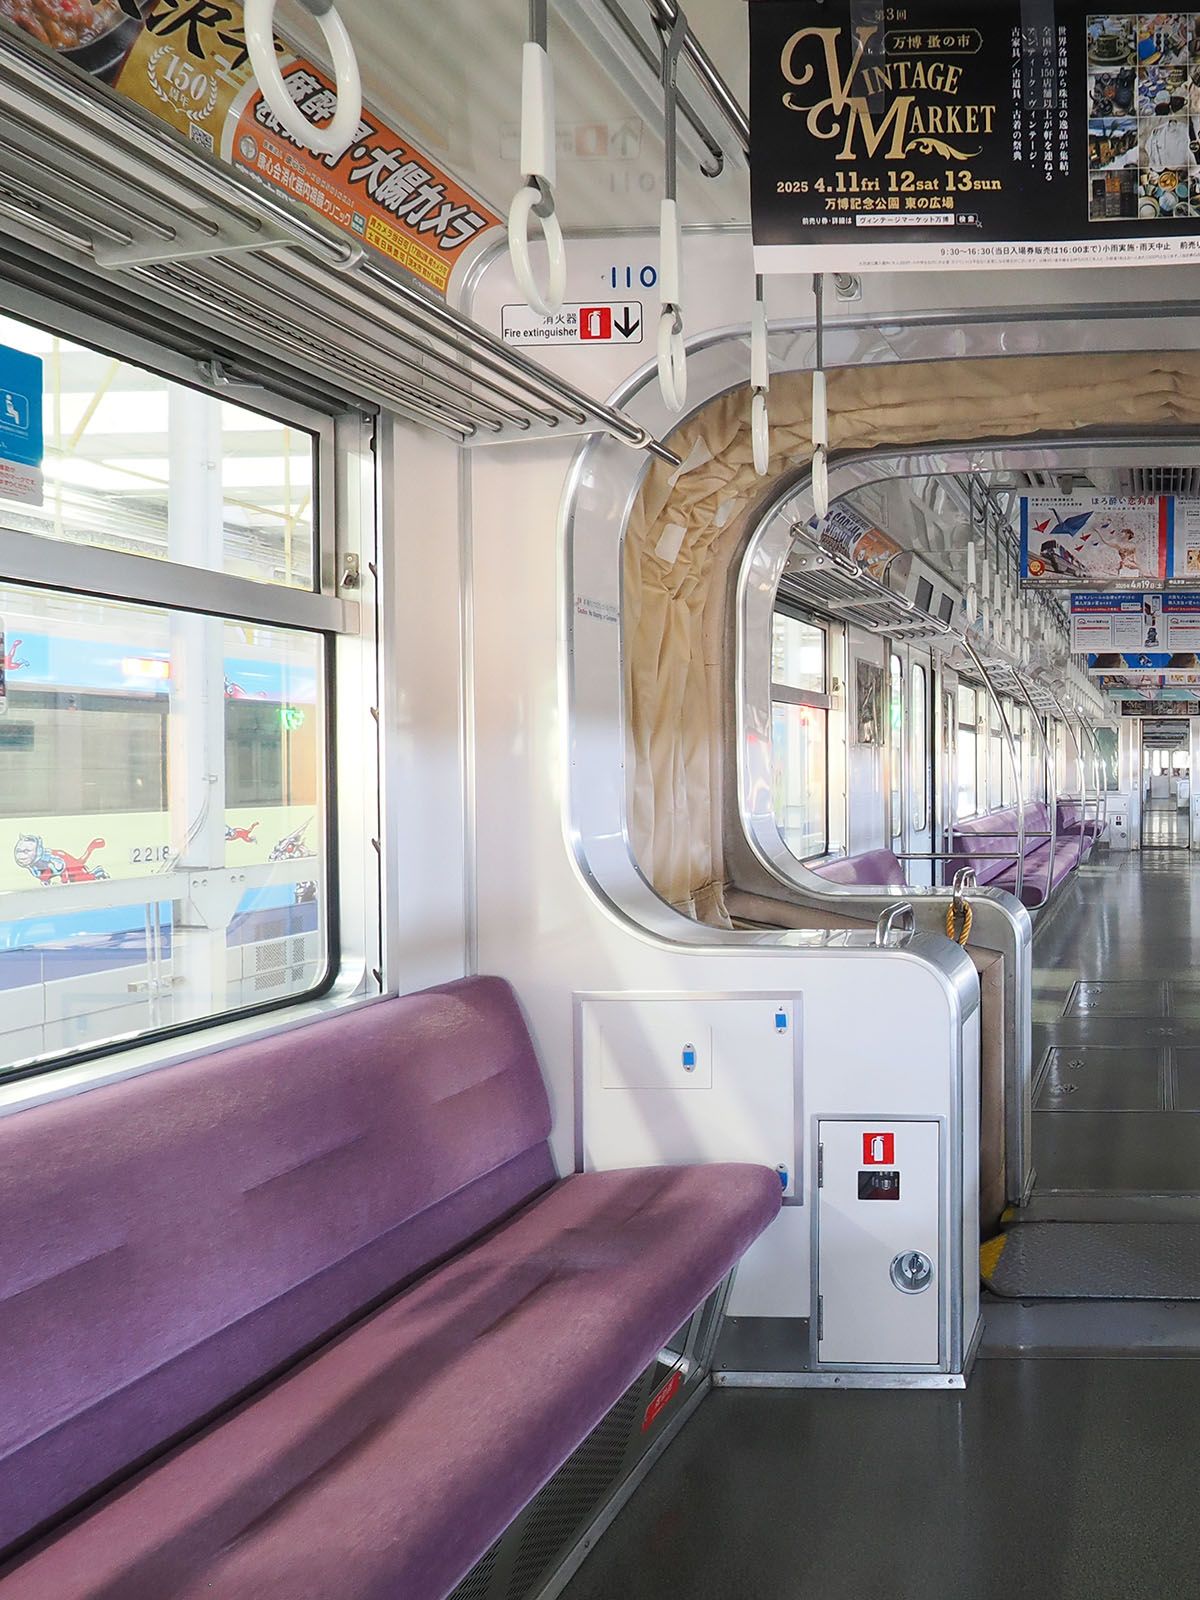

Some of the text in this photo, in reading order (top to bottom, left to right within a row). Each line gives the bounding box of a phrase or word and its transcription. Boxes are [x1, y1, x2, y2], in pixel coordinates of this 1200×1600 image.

[892, 34, 971, 49] 万博 蚤の市
[162, 53, 208, 100] 150
[781, 26, 964, 116] VINTAGE
[782, 92, 996, 161] MARKET
[776, 170, 1002, 193] 2025 4.11fri 12sat 13sun
[824, 196, 954, 210] 万博記念公園 東の広場
[611, 265, 657, 289] 110
[543, 313, 577, 325] 消火器
[504, 326, 578, 339] Fire extinguisher
[133, 847, 170, 863] 2218
